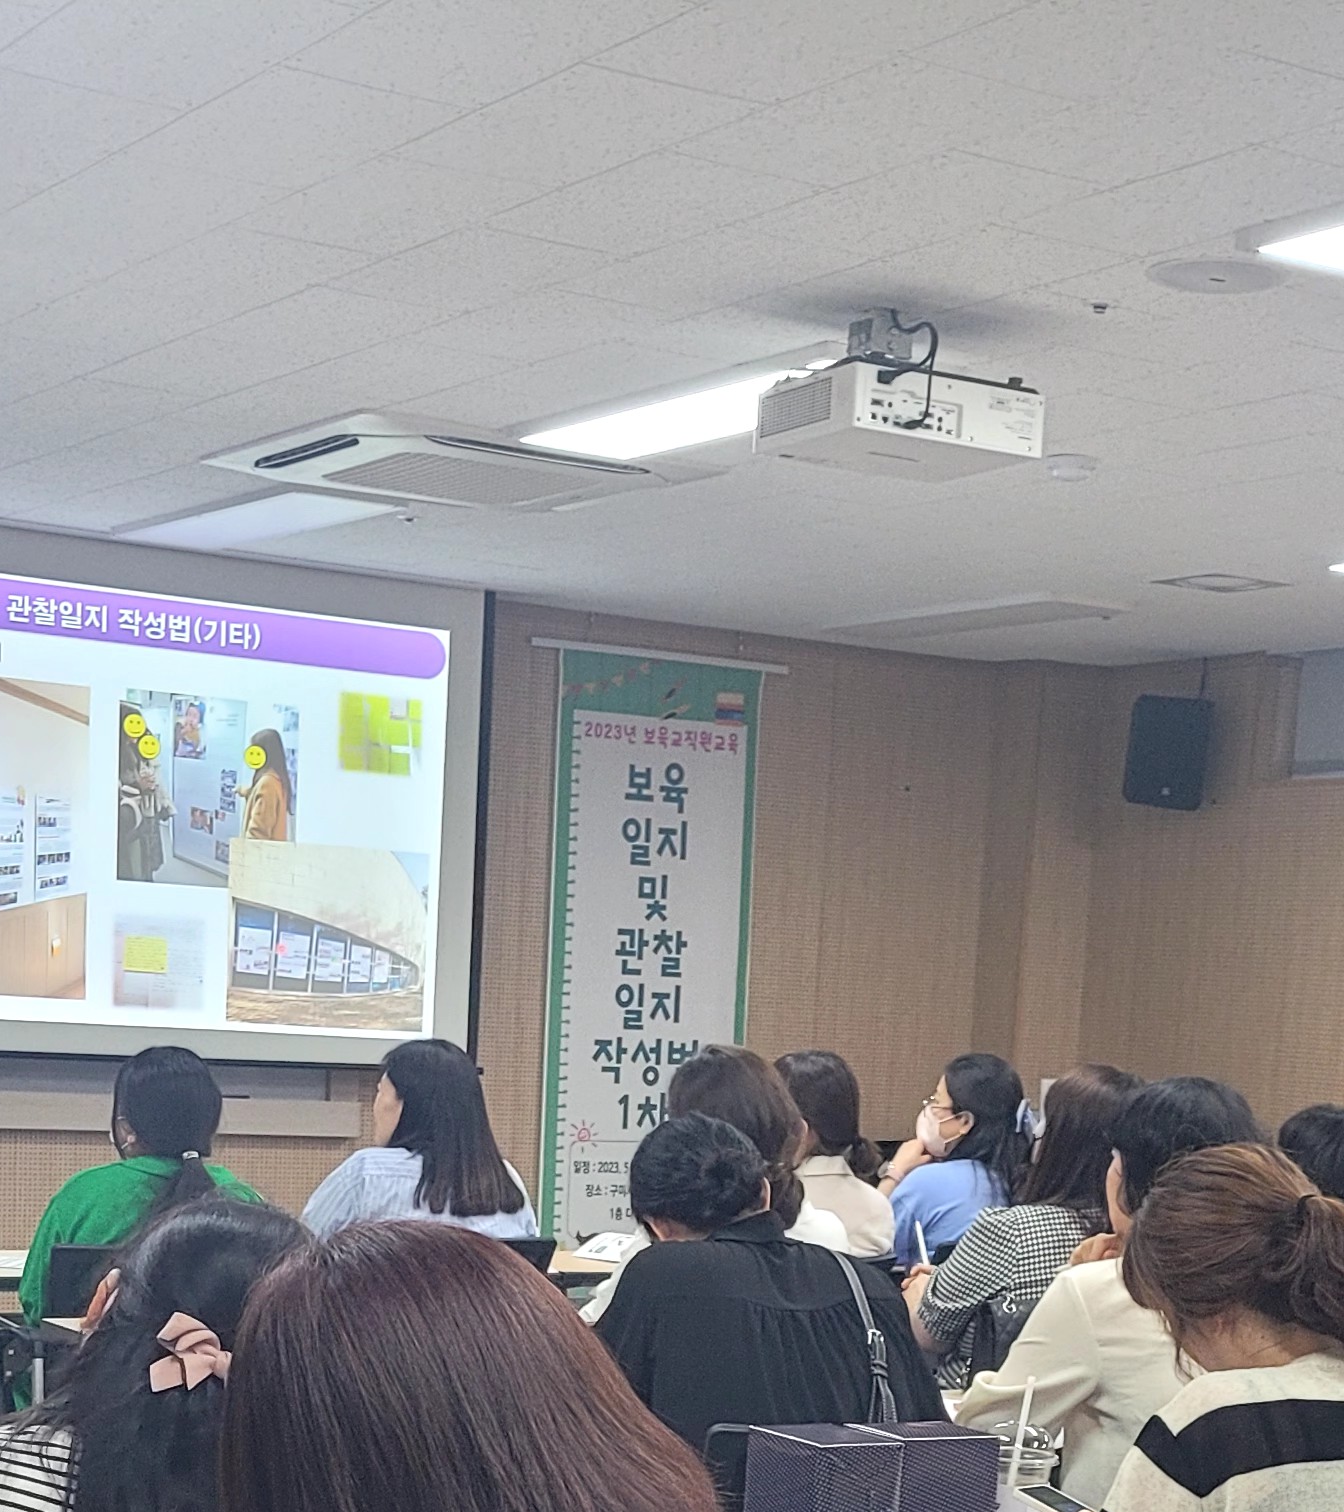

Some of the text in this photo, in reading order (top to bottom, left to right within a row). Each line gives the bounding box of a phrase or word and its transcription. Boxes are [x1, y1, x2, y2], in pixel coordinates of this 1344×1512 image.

[6, 594, 261, 650] 관찰일지 작성법(기타)
[584, 721, 739, 755] 2023년 보육교직원교육
[624, 762, 689, 813] 보육
[620, 817, 688, 867] 일지
[637, 874, 668, 921] 및
[614, 928, 688, 978] 관찰
[614, 983, 682, 1030] 일지
